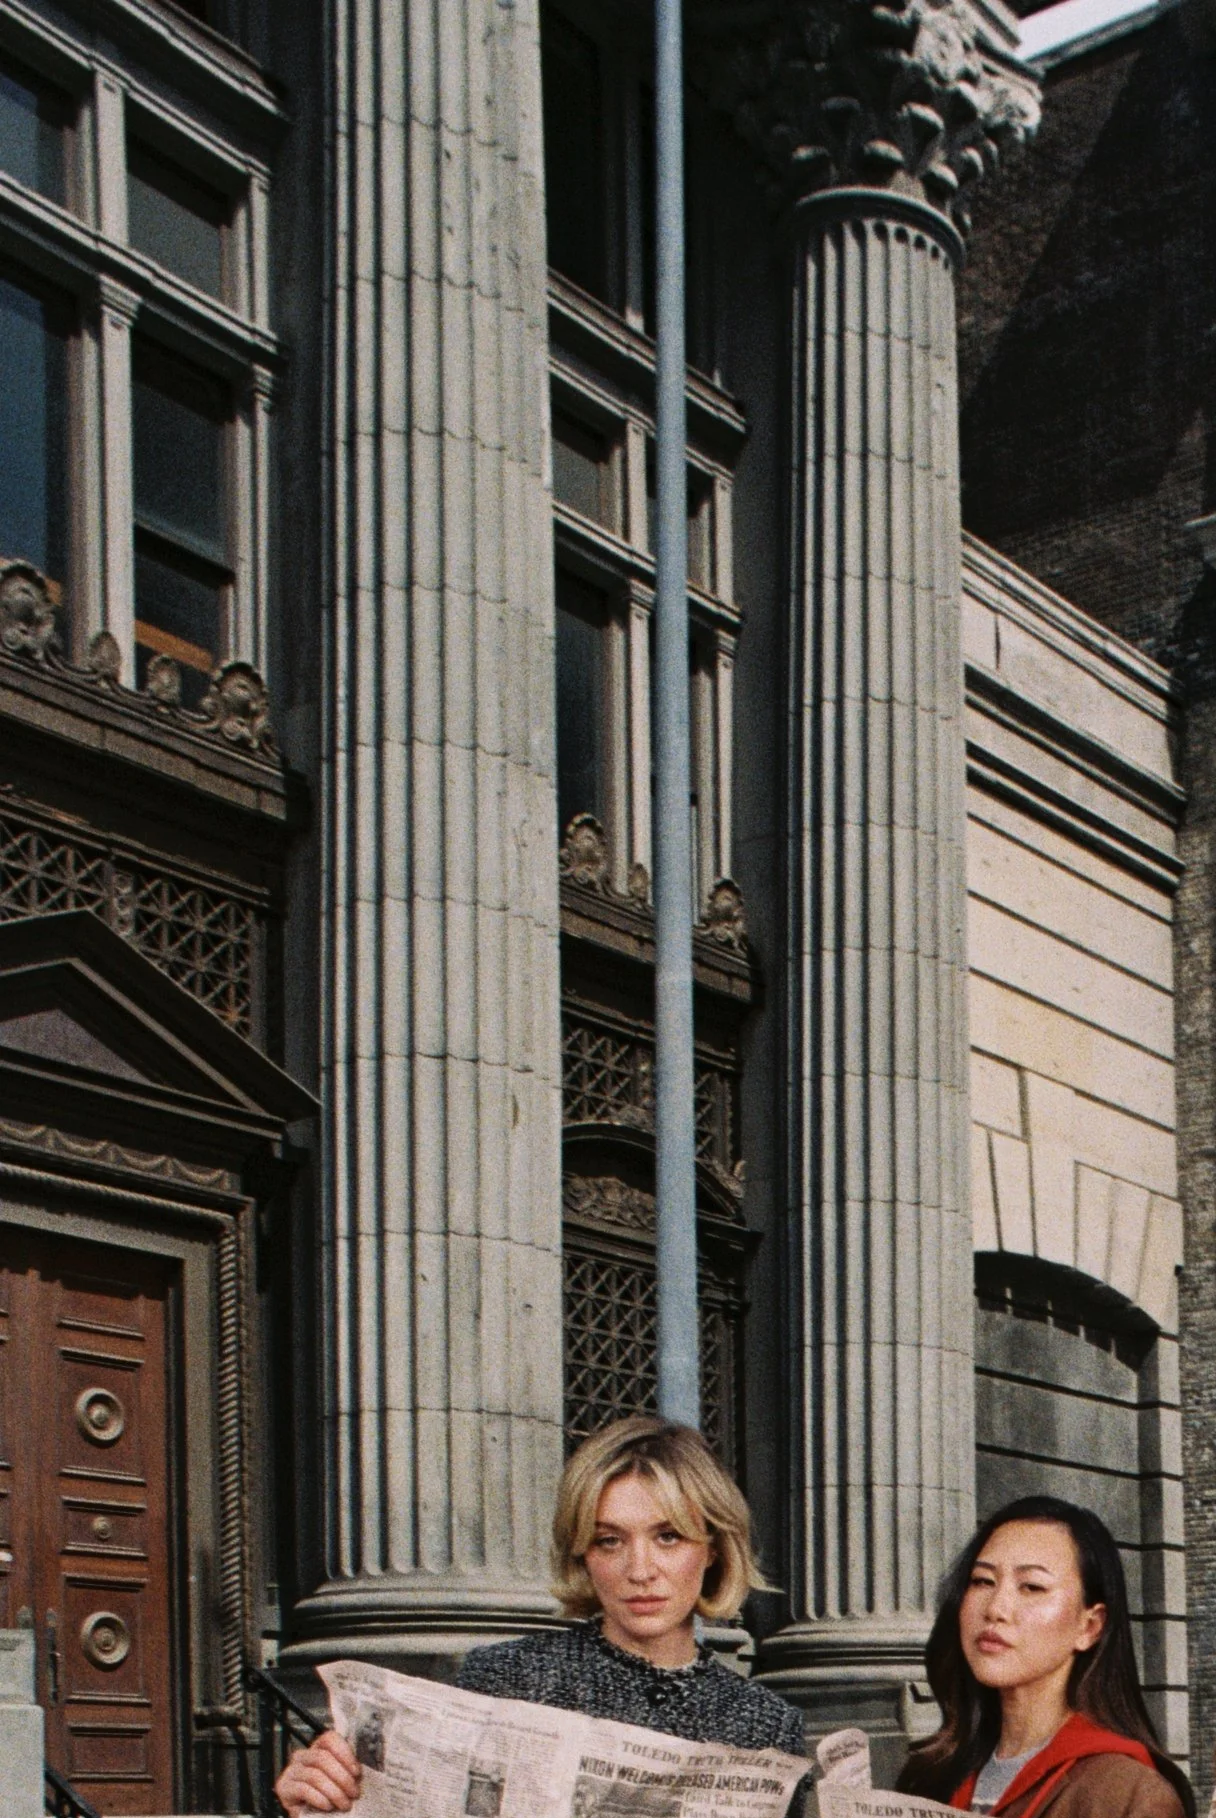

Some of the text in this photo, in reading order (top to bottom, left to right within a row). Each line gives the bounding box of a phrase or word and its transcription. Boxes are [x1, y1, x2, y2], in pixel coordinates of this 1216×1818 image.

[622, 1740, 682, 1765] TOLEDO
[578, 1755, 615, 1778] NIXON
[714, 1775, 760, 1794] AMERICAN
[854, 1801, 903, 1817] TOLEDO
